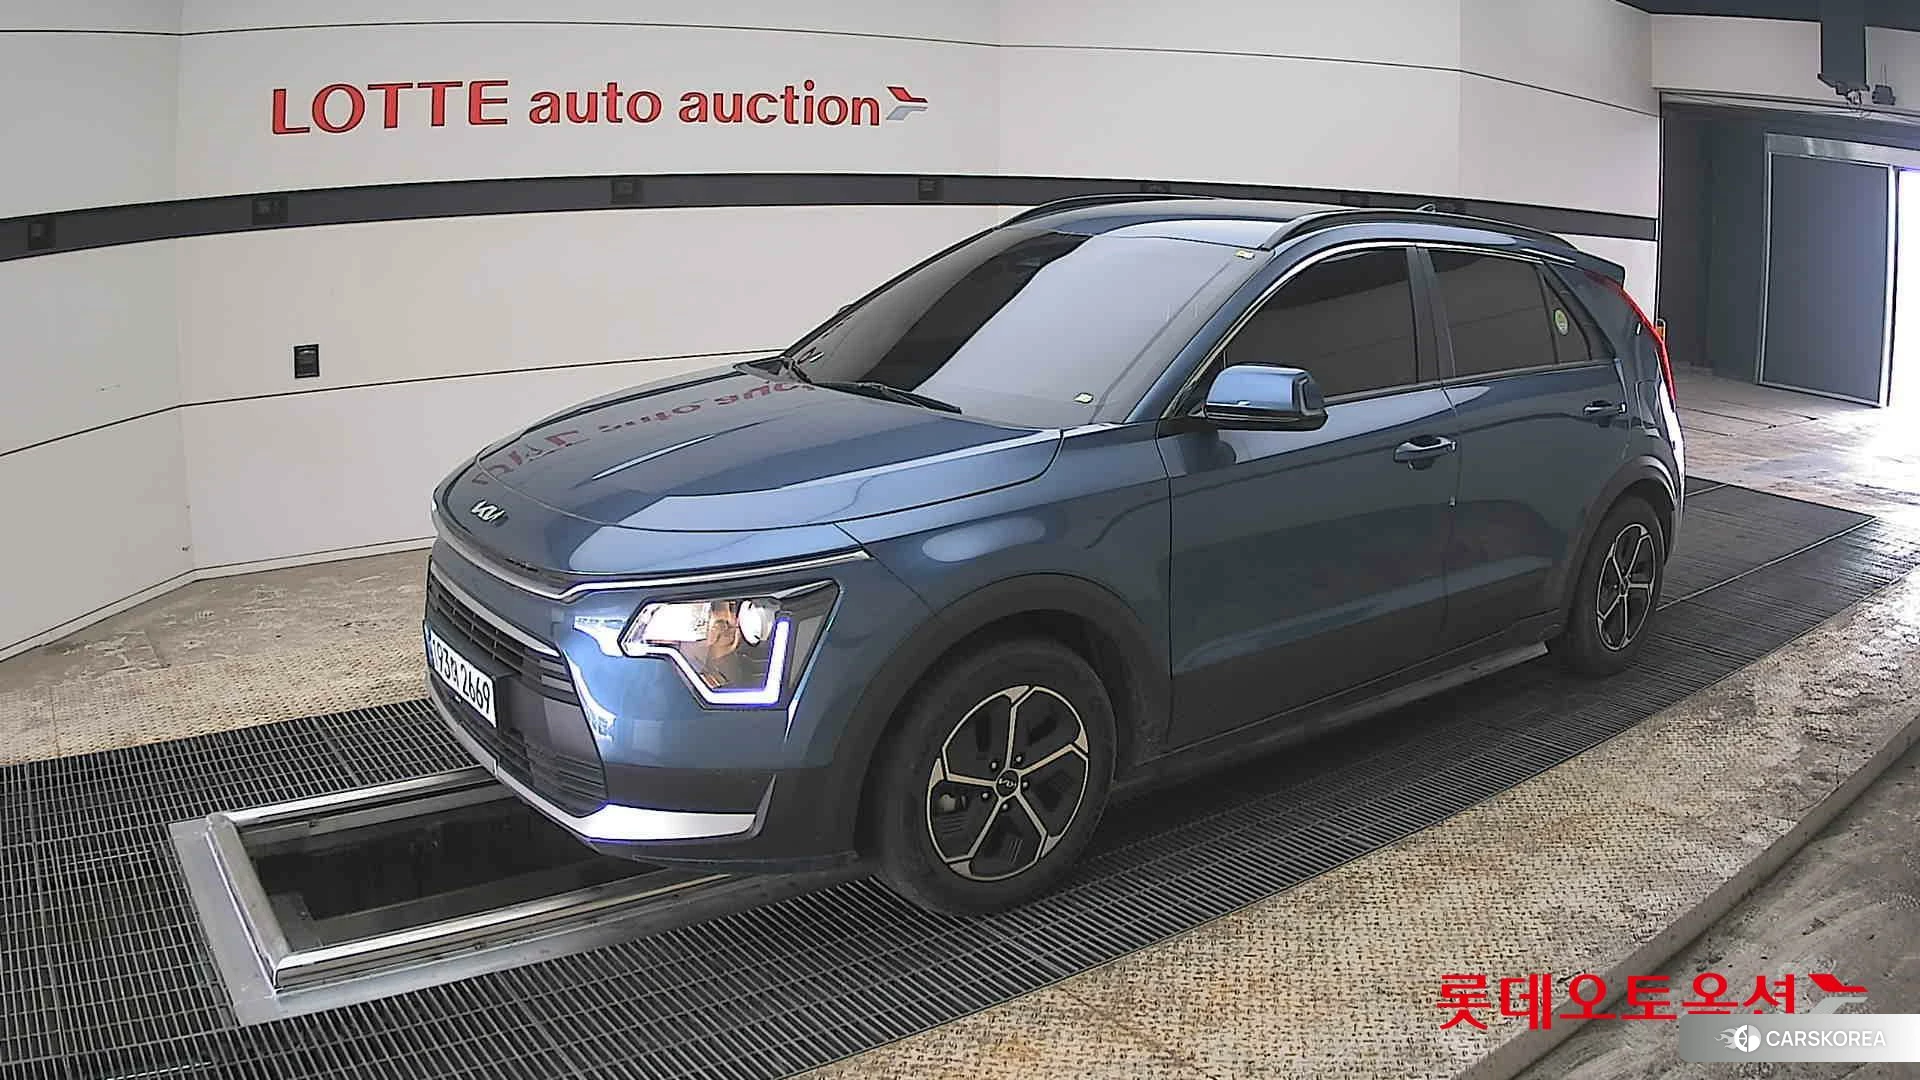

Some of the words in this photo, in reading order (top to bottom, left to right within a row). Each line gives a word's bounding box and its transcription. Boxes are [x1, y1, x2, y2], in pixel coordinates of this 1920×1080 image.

[272, 81, 508, 134] LOTTE
[529, 81, 661, 125] auto
[679, 79, 880, 126] auction
